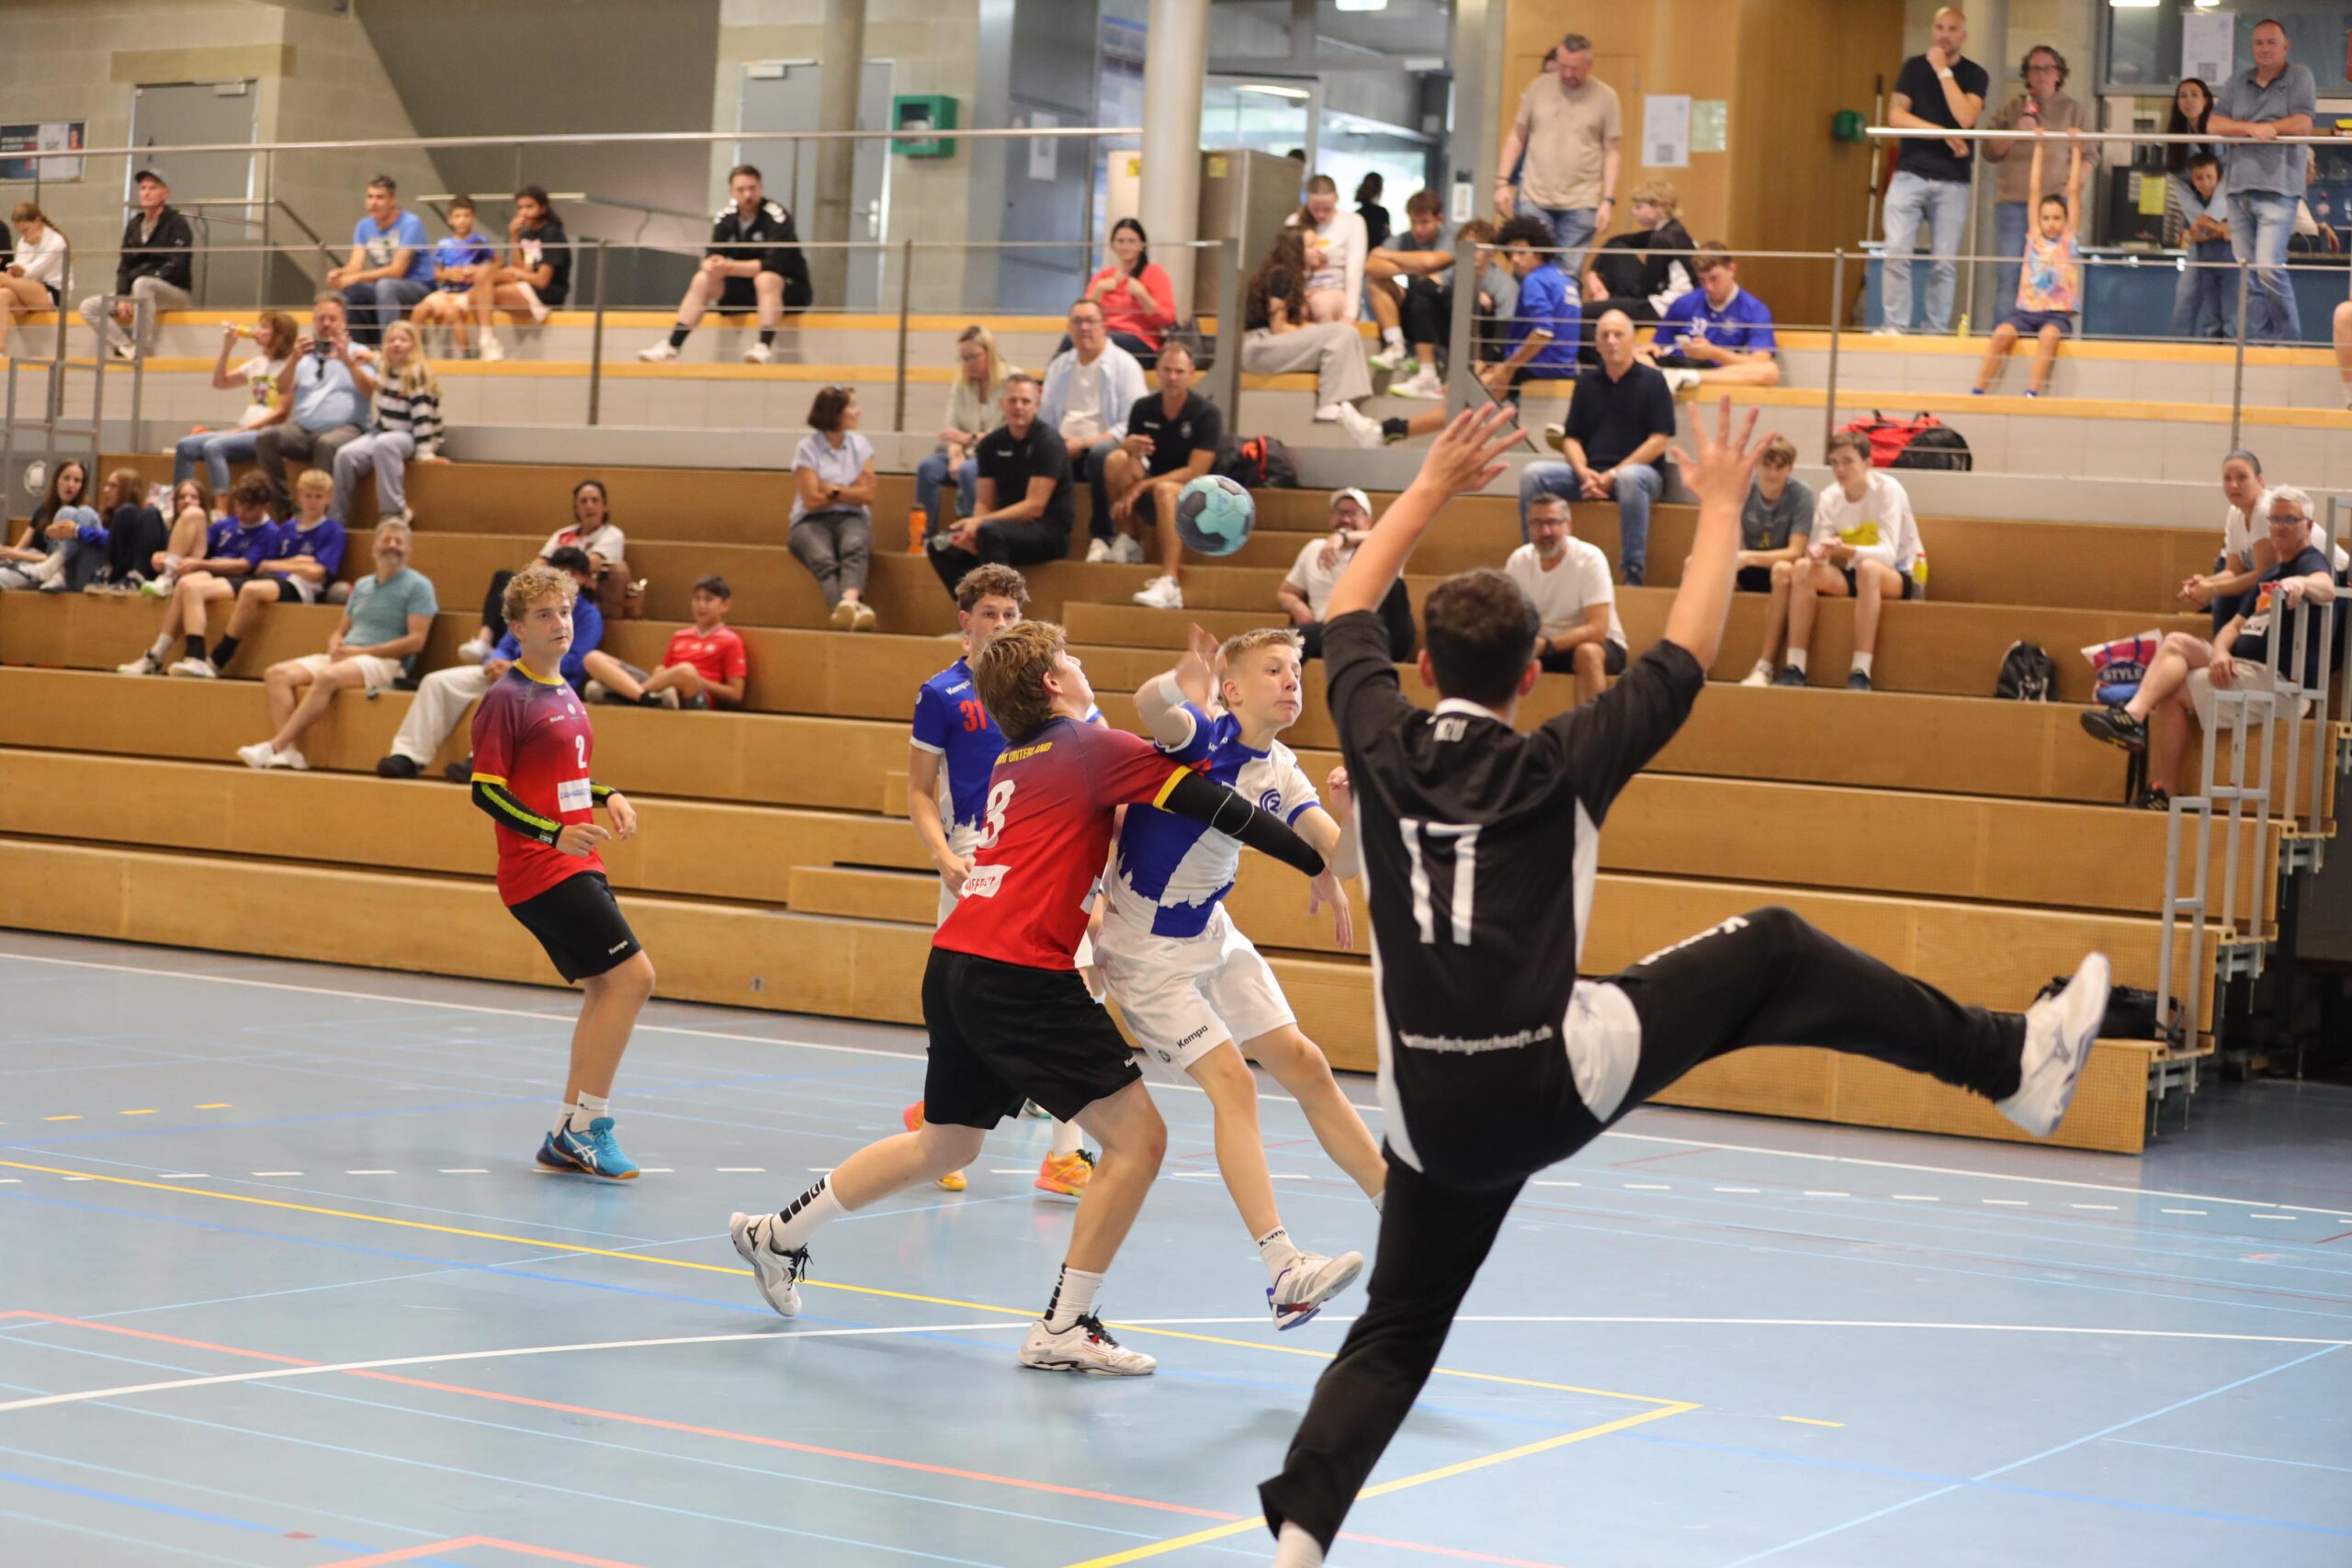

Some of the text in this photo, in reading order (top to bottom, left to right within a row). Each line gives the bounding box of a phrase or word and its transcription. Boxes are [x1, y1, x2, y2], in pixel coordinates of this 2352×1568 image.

[945, 680, 971, 696] Kempa
[959, 699, 988, 732] 31
[575, 734, 587, 770] 2
[1009, 741, 1053, 763] UNTERLAND
[978, 779, 1016, 850] 8
[1398, 818, 1483, 947] 17
[1176, 1024, 1209, 1049] Kempa
